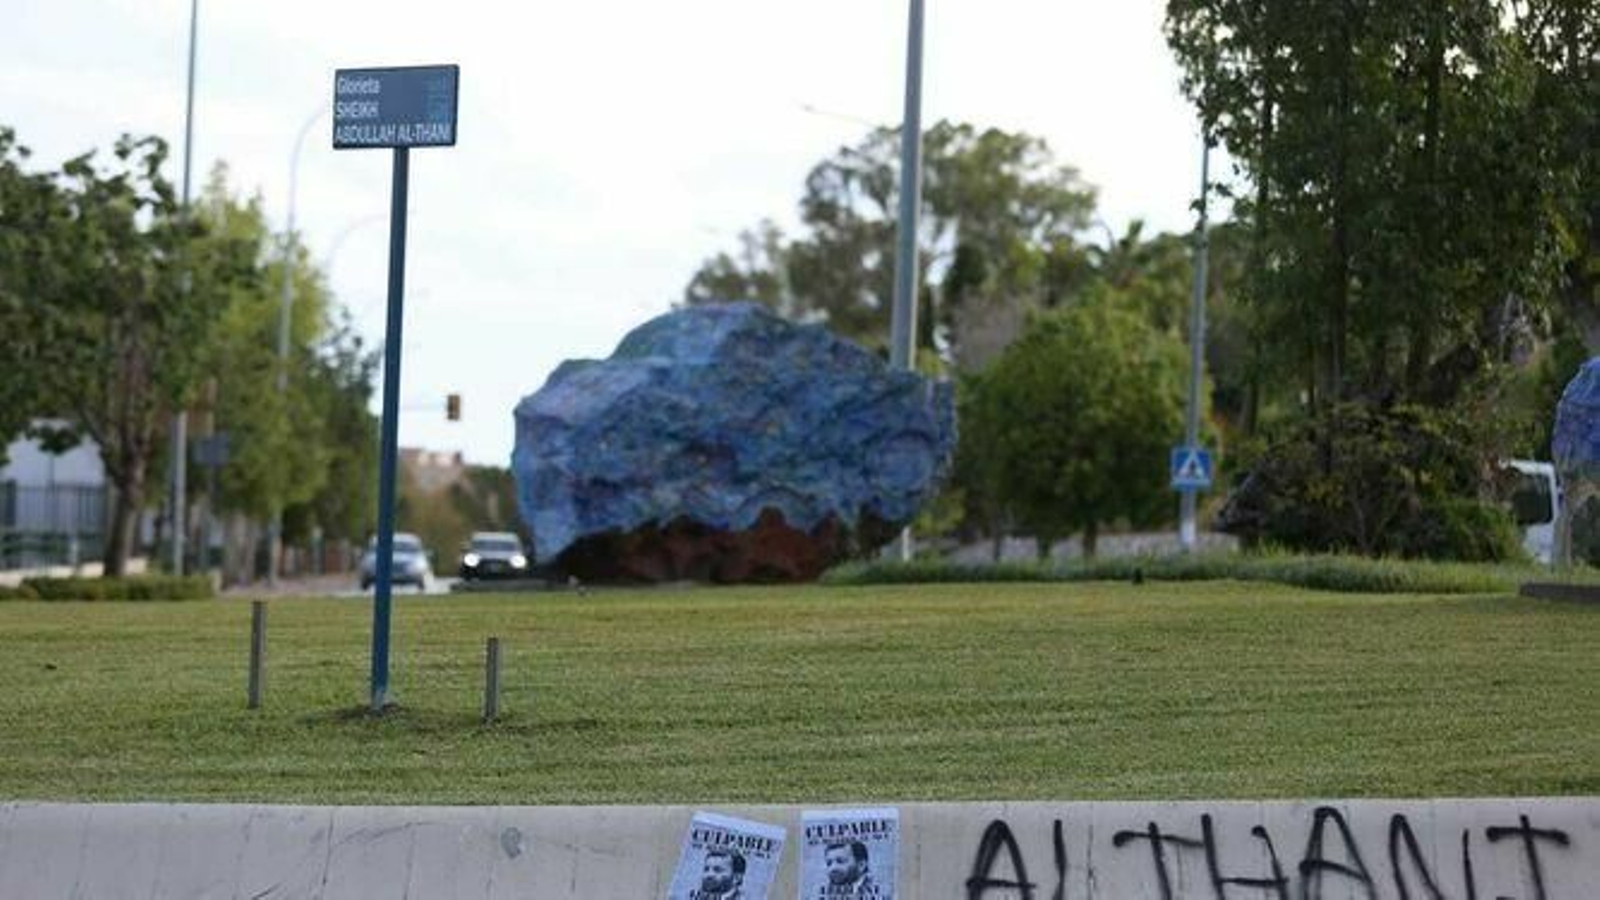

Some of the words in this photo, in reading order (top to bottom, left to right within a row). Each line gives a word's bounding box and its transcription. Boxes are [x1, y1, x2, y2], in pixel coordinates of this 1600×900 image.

[337, 77, 380, 94] Glorieta
[336, 101, 379, 118] SHEIKH
[336, 124, 396, 143] ABDULLAH
[397, 123, 450, 142] AL-THANI
[806, 820, 892, 838] CULPABLE
[691, 827, 780, 853] CULPABLE
